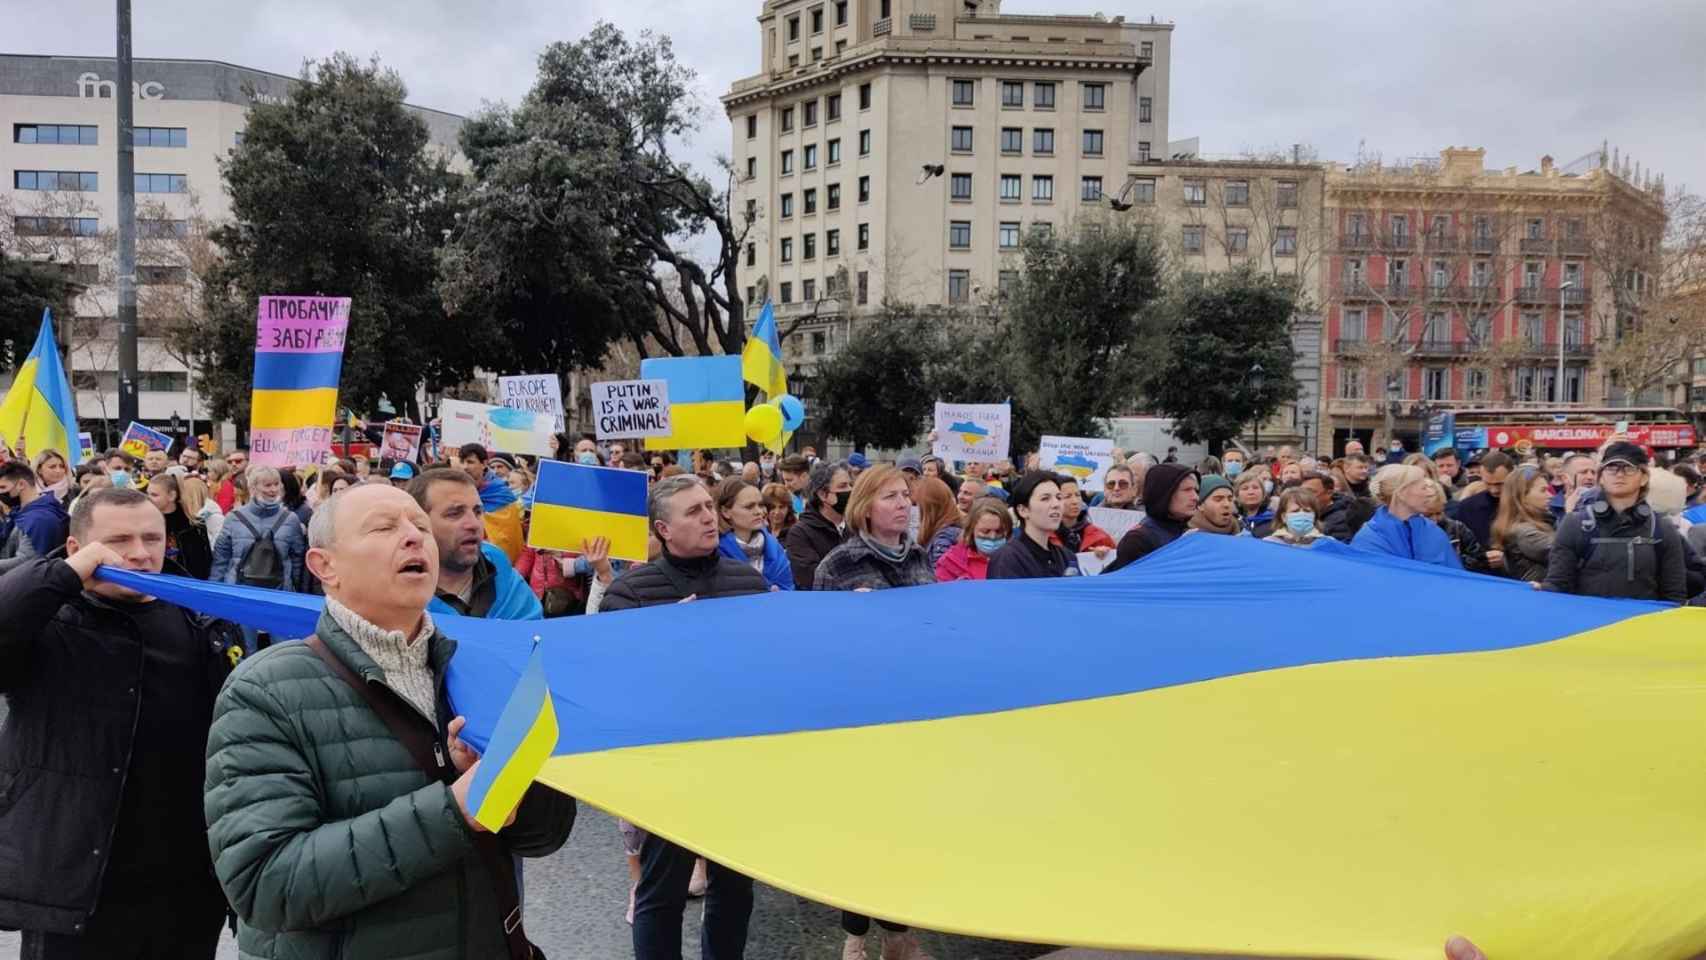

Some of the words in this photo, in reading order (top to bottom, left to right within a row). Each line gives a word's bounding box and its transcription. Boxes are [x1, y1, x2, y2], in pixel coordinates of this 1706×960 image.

[507, 379, 548, 397] EUROPE
[607, 384, 650, 398] PUTIN
[601, 400, 614, 414] IS
[618, 399, 628, 412] A
[632, 397, 659, 410] WAR
[600, 413, 665, 433] CRIMINAL
[1534, 428, 1599, 440] BARCELONA
